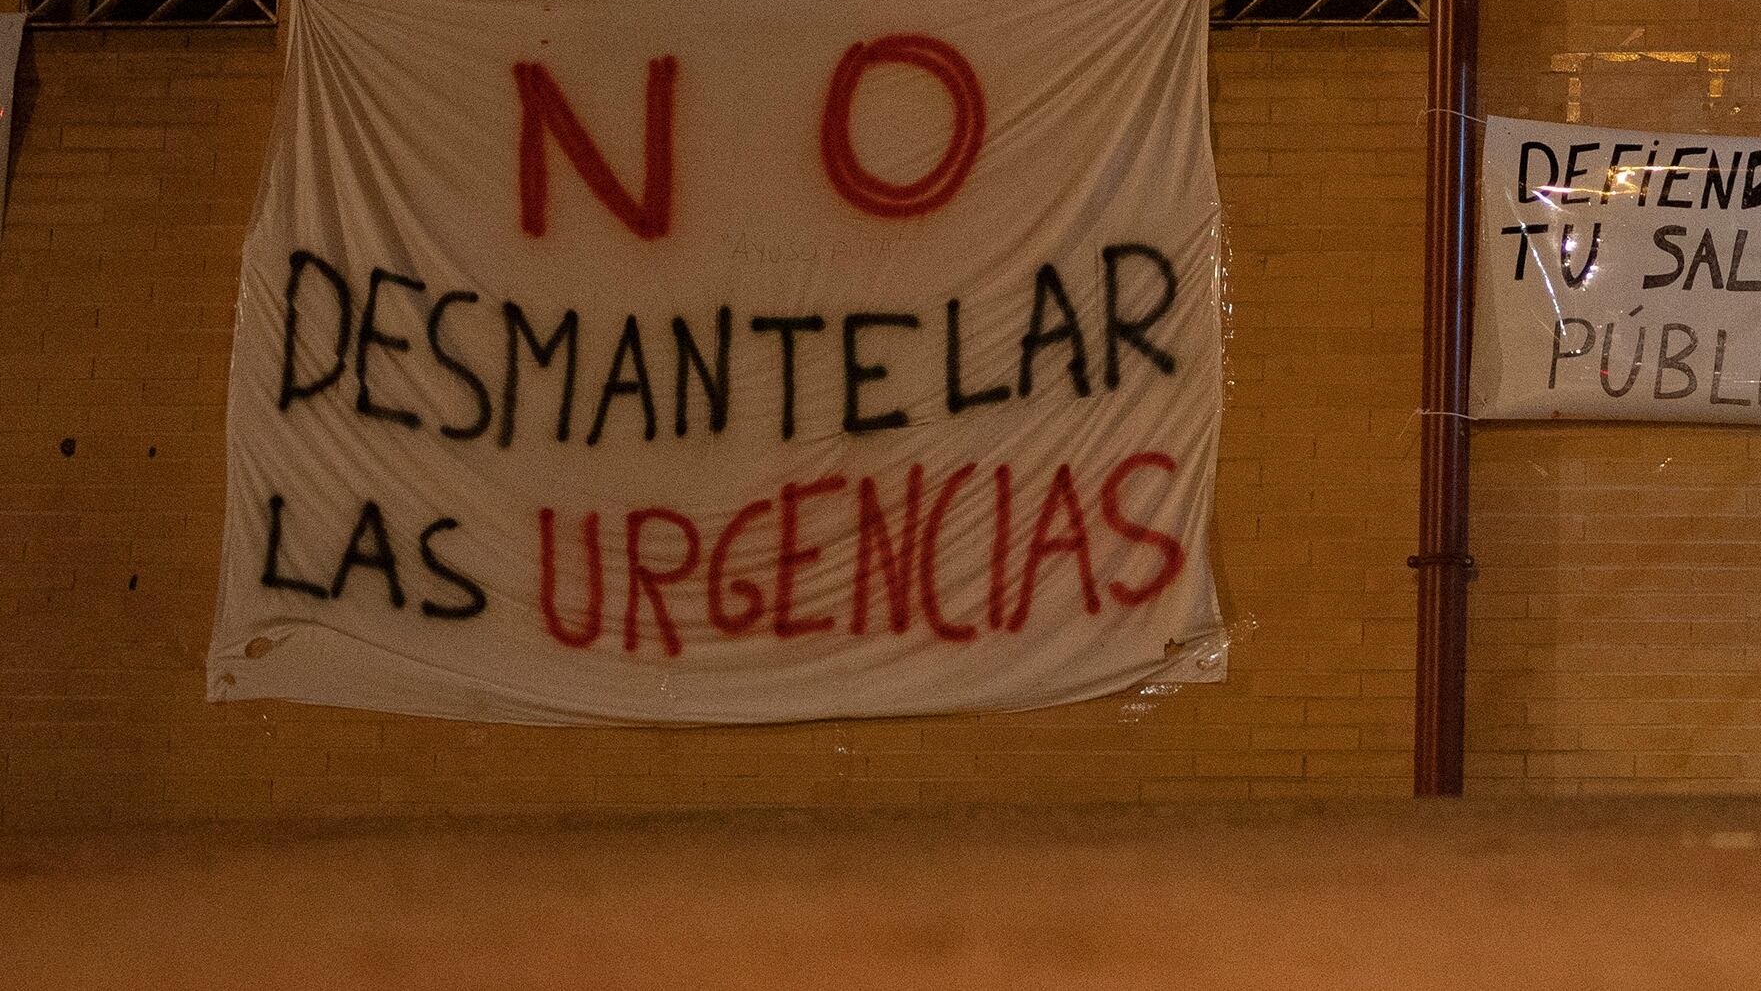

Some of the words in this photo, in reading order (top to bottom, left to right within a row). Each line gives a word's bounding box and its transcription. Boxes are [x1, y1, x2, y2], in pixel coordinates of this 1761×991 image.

[276, 242, 1181, 448] DESMANTELAR
[1500, 222, 1603, 290] TU
[260, 494, 488, 618] LAS
[536, 450, 1188, 657] URGENCIAS
